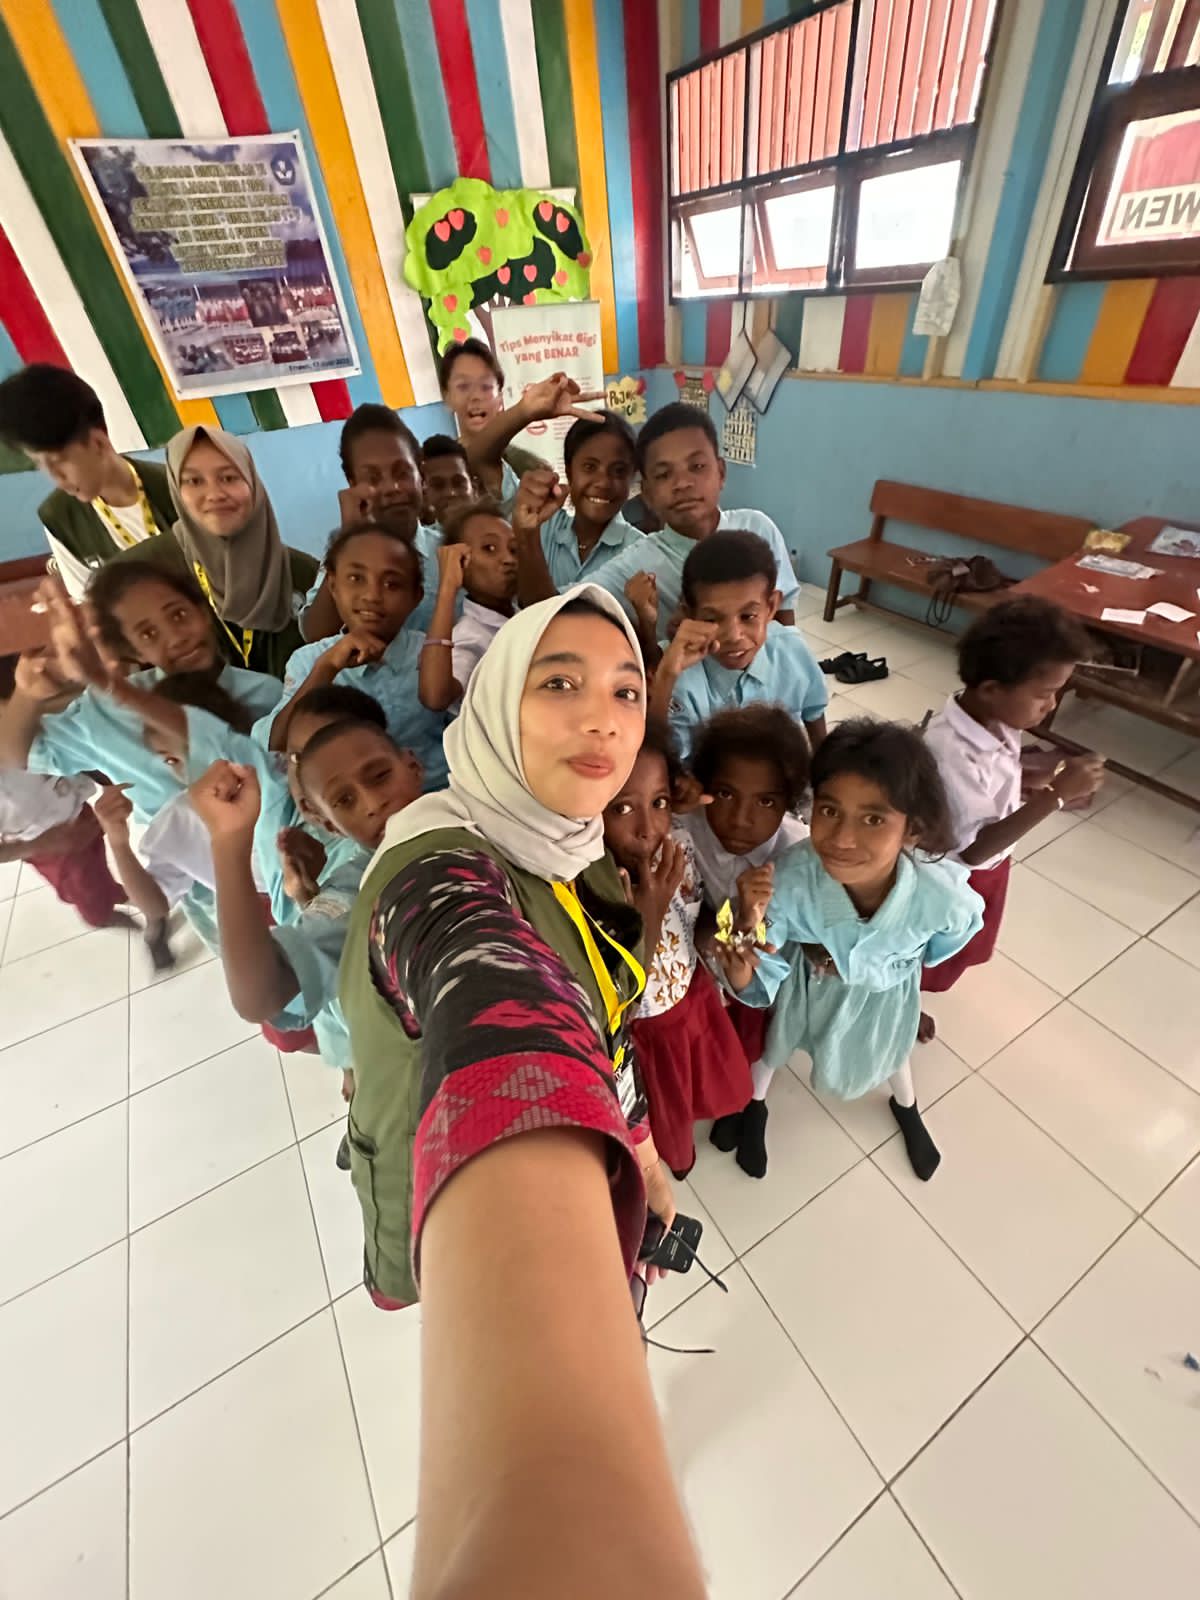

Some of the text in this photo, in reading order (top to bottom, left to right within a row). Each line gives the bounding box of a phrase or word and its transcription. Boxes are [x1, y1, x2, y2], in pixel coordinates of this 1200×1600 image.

[499, 331, 597, 353] Tips Menyikat Gigi
[515, 346, 579, 365] yang BENAR
